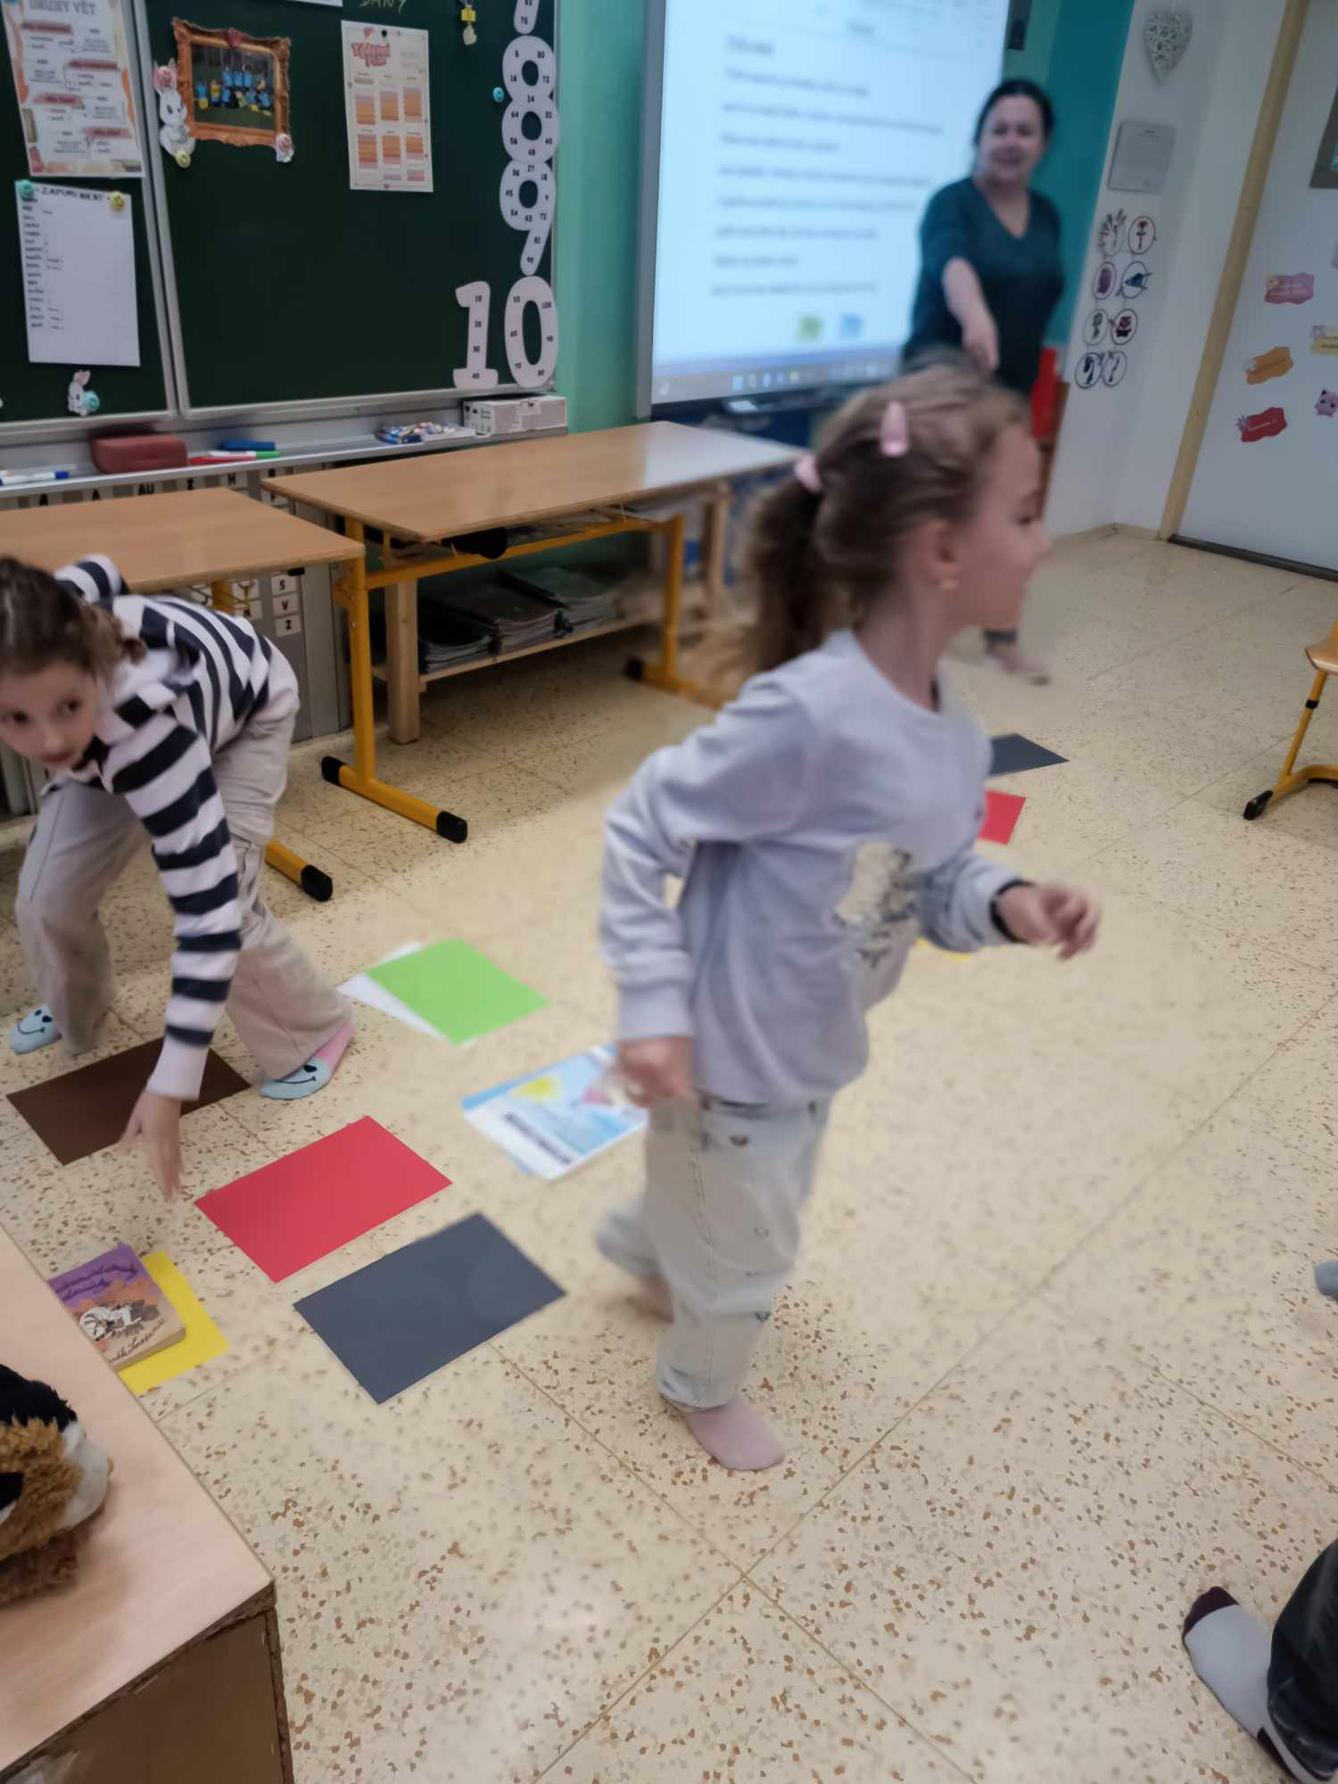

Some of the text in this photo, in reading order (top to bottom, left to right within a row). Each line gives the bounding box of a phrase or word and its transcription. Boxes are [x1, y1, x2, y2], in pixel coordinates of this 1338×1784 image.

[502, 35, 560, 163] 8
[499, 159, 556, 277] 9
[452, 276, 559, 389] 10
[279, 579, 286, 591] S
[281, 600, 289, 611] V
[285, 619, 293, 631] Z
